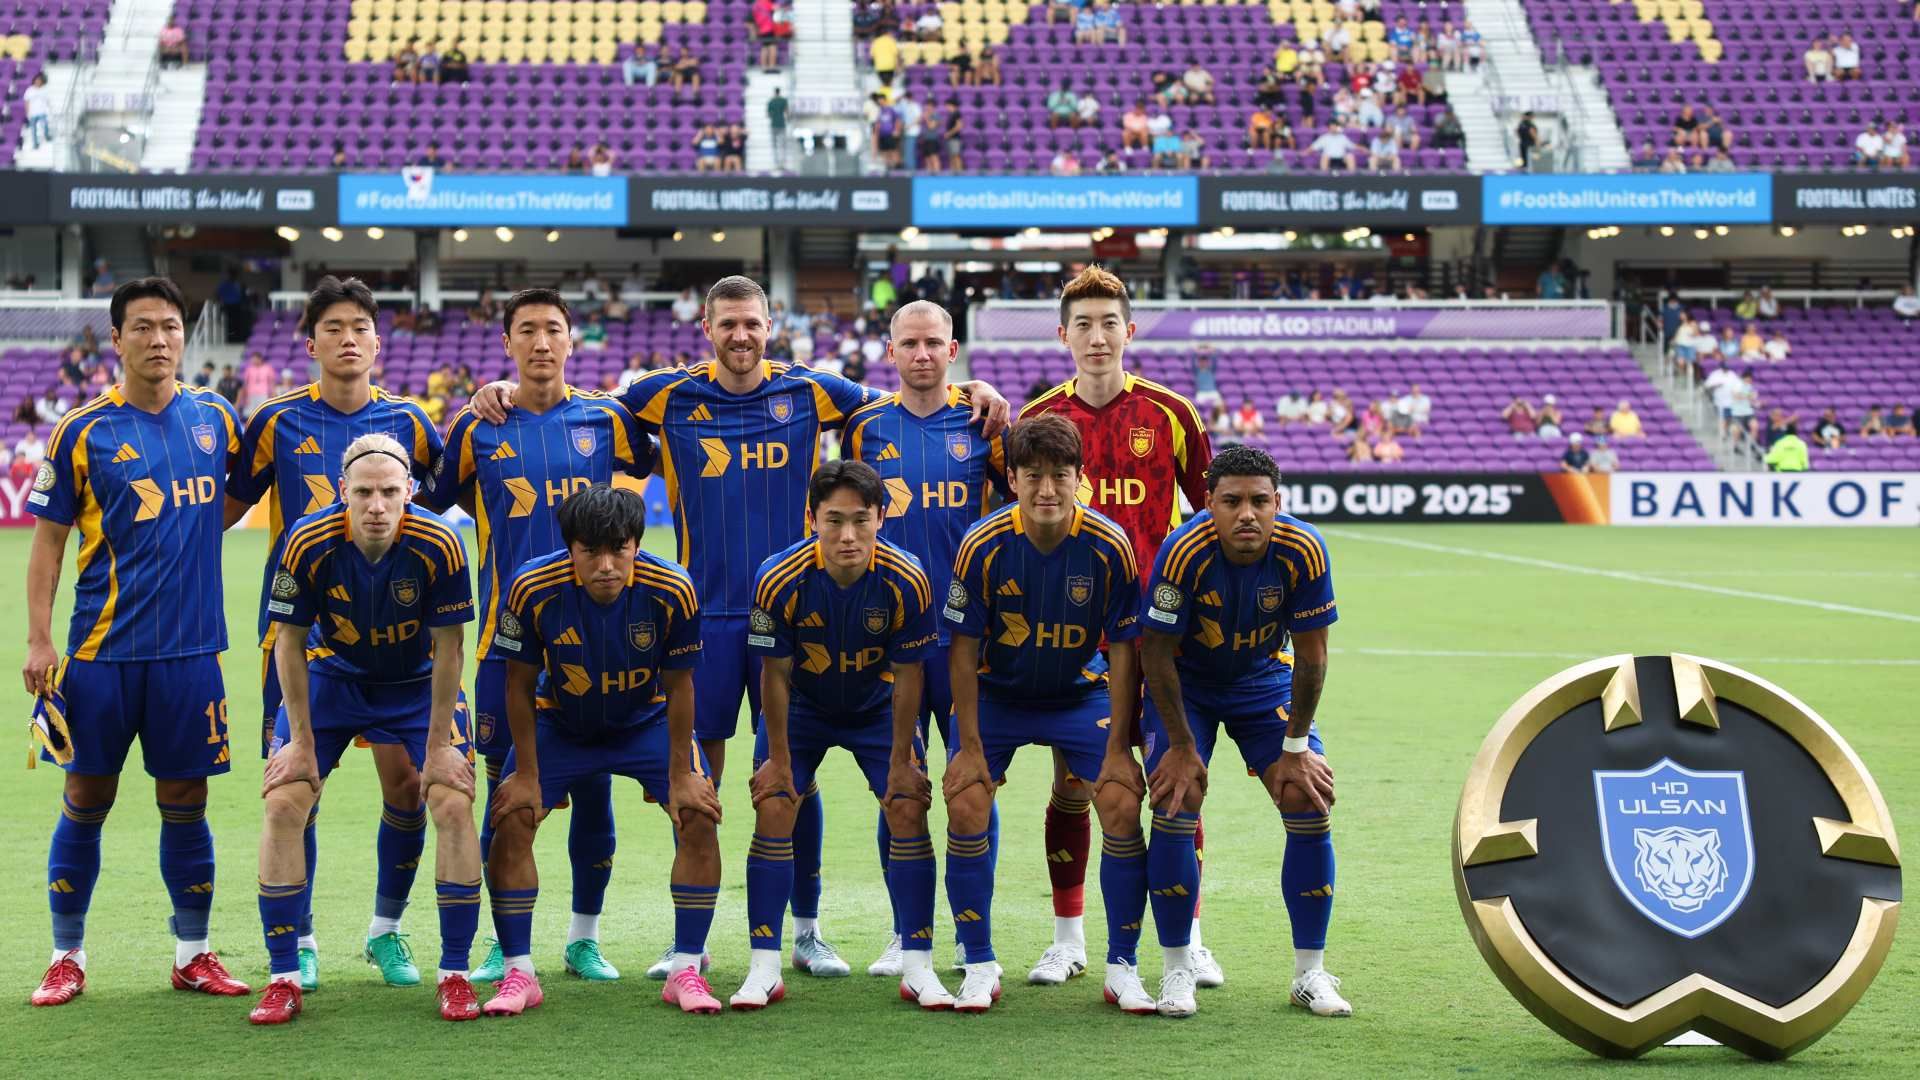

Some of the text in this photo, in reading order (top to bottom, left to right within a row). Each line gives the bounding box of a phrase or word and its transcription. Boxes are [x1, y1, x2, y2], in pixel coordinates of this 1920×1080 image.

[70, 187, 139, 210] FOOTBALL
[141, 186, 193, 210] UNITES
[651, 188, 719, 210] FOOTBALL
[720, 187, 770, 210] UNITES
[929, 189, 1184, 210] #FootballUnitesTheWorld
[1221, 188, 1289, 211] FOOTBALL
[1290, 188, 1339, 211] UNITES
[1499, 188, 1757, 209] #FootballUnitesTheWorld
[1796, 186, 1917, 208] FOOTBALL UNITES
[1310, 316, 1397, 336] STADIUM
[741, 442, 789, 470] HD
[171, 475, 217, 508] HD
[921, 481, 968, 508] HD
[1099, 478, 1147, 505] HD
[1342, 484, 1417, 516] CUP
[1630, 481, 1905, 518] BANK OF
[369, 619, 421, 647] HD
[1035, 622, 1088, 649] HD
[1232, 621, 1278, 651] HD
[669, 640, 703, 656] DEVEL
[839, 646, 885, 673] HD
[601, 667, 652, 695] HD
[1651, 781, 1689, 795] HD
[1618, 799, 1727, 815] ULSAN
